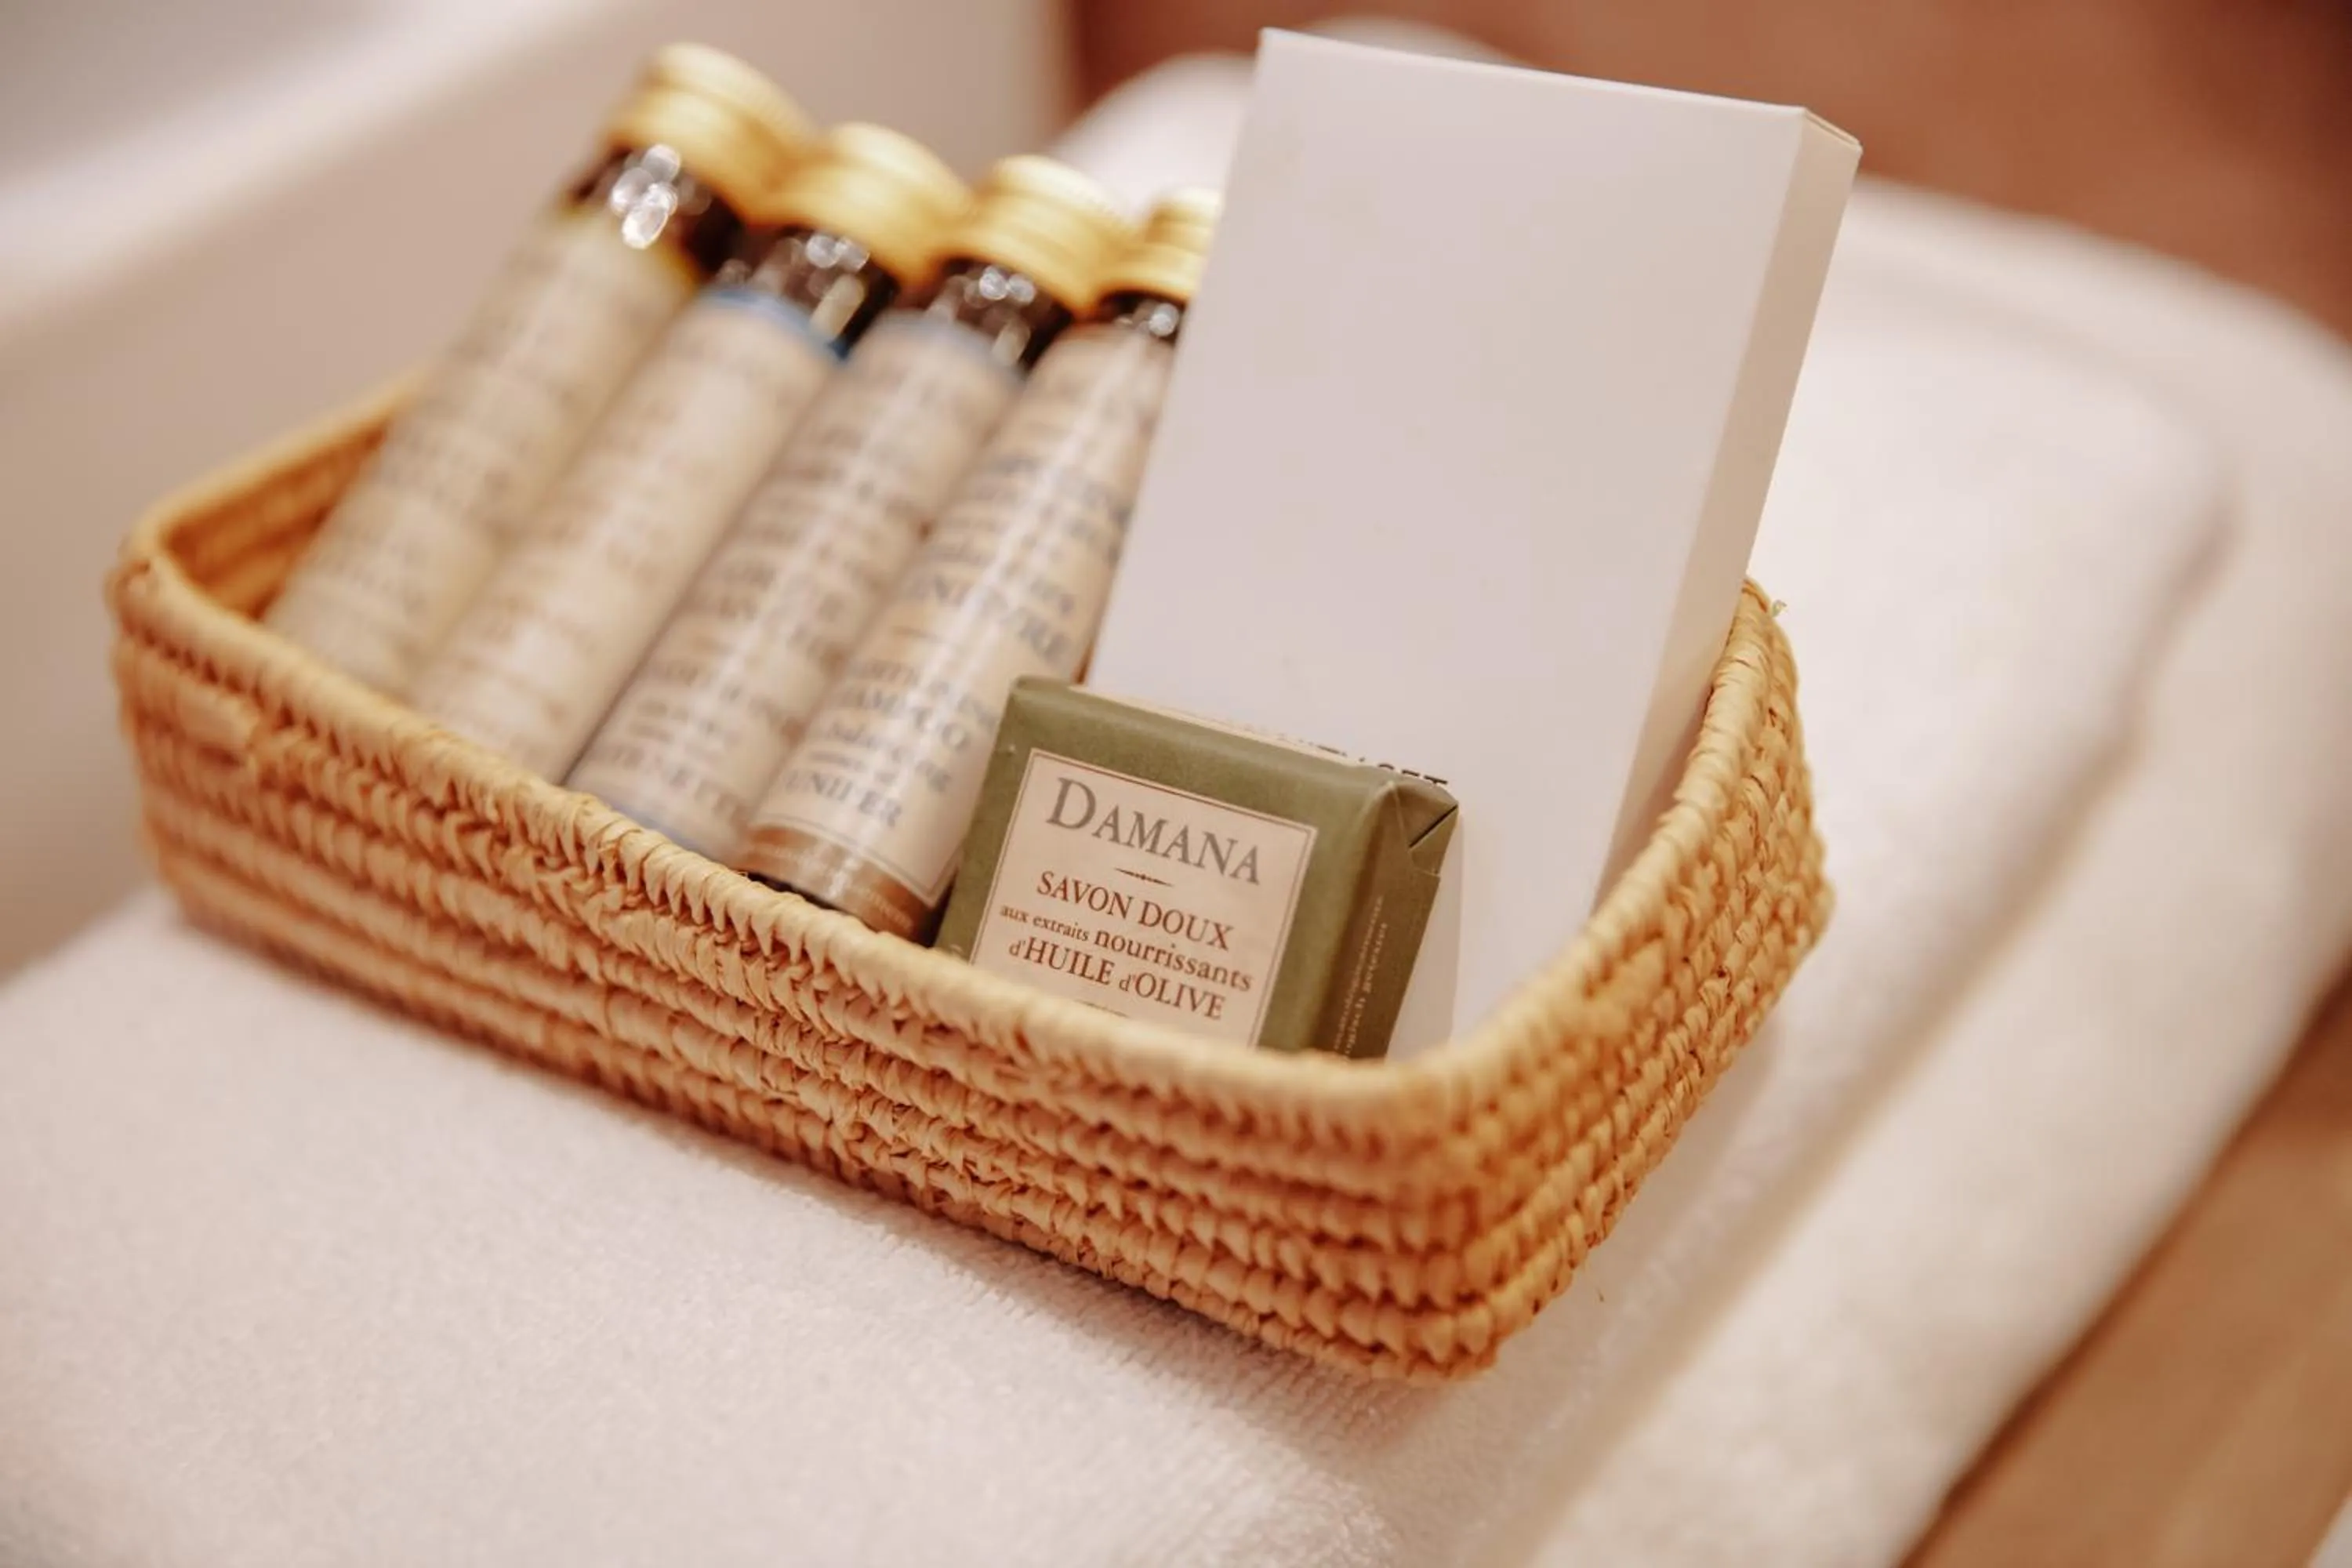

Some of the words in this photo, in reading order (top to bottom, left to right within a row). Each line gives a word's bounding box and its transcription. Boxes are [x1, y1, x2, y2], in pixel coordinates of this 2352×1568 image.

[1046, 775, 1261, 885] DAMANA
[1000, 905, 1029, 924] aux
[1033, 912, 1090, 942] extraits
[1094, 930, 1252, 993] nourrissants
[1036, 871, 1132, 919] SAVON
[1141, 902, 1235, 952] DOUX
[1009, 939, 1115, 986] d'HUILE
[1119, 972, 1226, 1020] d'OLIVE
